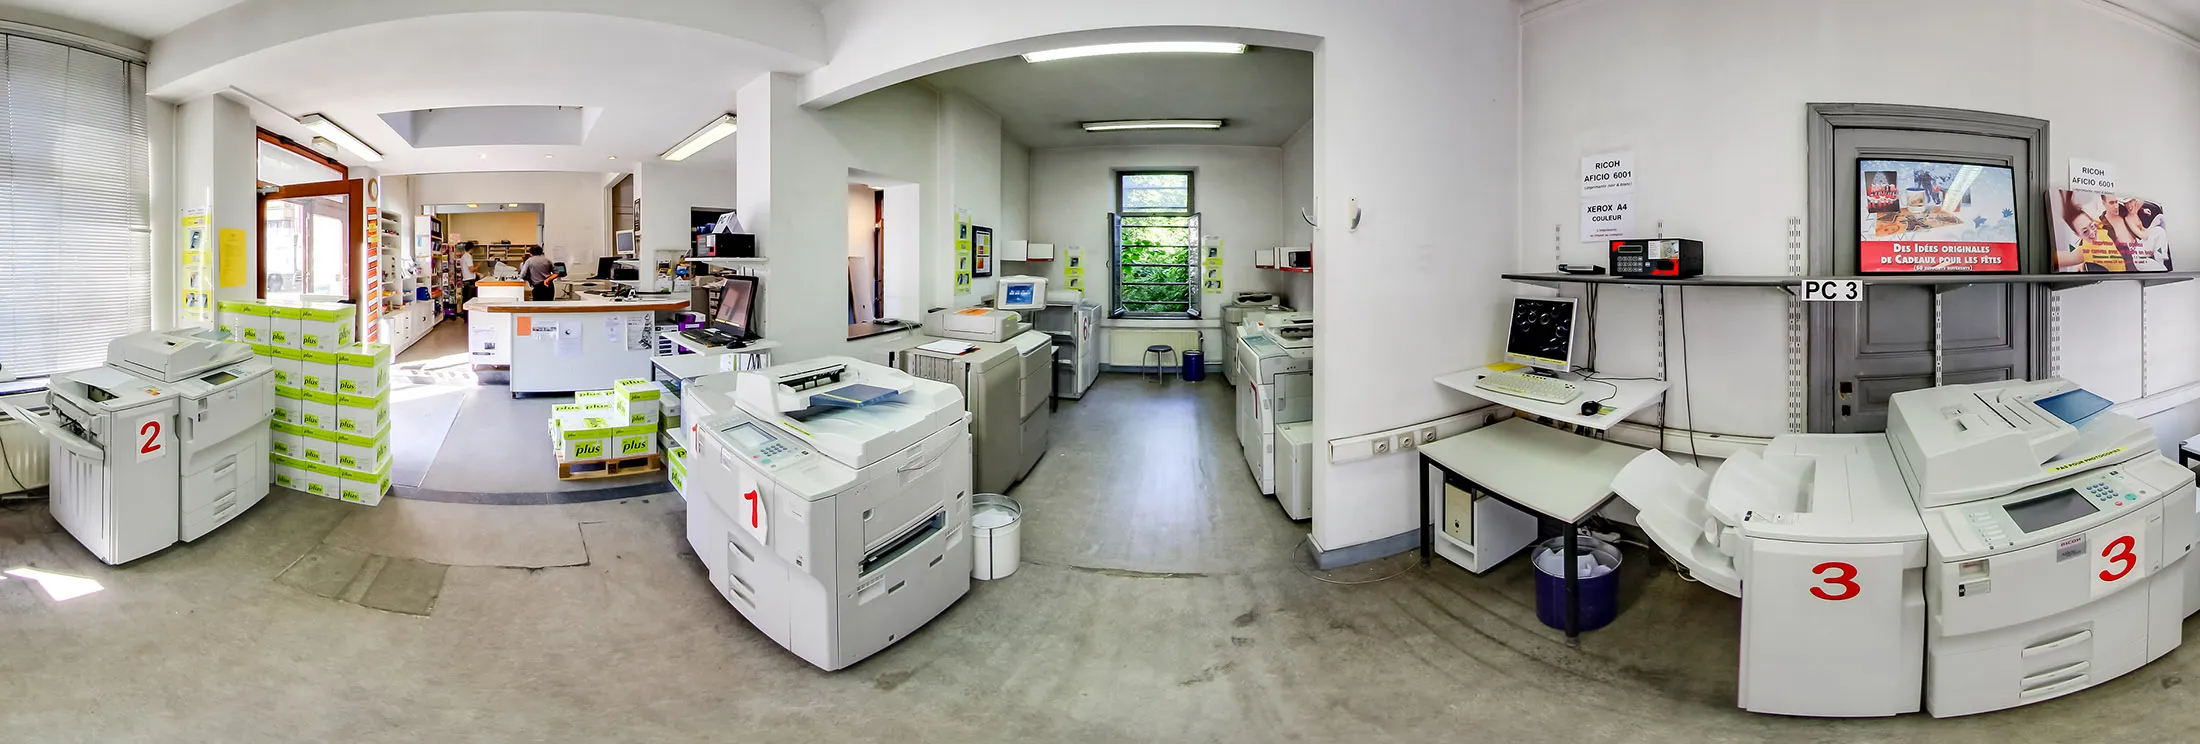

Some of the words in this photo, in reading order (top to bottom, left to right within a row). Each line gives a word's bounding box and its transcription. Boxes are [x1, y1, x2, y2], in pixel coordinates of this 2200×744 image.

[1595, 160, 1620, 169] RICOH
[2082, 167, 2105, 176] RICOH
[1584, 173, 1610, 182] AFICIO
[1613, 171, 1631, 179] 6001
[2072, 177, 2096, 186] AFICIO
[1587, 205, 1613, 213] XEROX
[1806, 281, 1837, 300] PC
[1846, 282, 1858, 300] 3
[244, 330, 256, 338] plus
[272, 333, 285, 342] plus
[303, 336, 318, 346] plus
[304, 377, 318, 386] plus
[340, 382, 354, 390] plus
[304, 415, 318, 424] plus
[340, 420, 354, 428] plus
[140, 421, 161, 454] 2
[692, 424, 698, 452] 1
[575, 444, 600, 456] plus
[622, 440, 646, 453] plus
[305, 450, 319, 458] plus
[340, 456, 354, 464] plus
[308, 484, 322, 493] plus
[343, 490, 358, 499] plus
[744, 490, 758, 528] 1
[2060, 538, 2081, 546] RICOH
[2099, 536, 2136, 582] 3
[1810, 562, 1860, 600] 3
